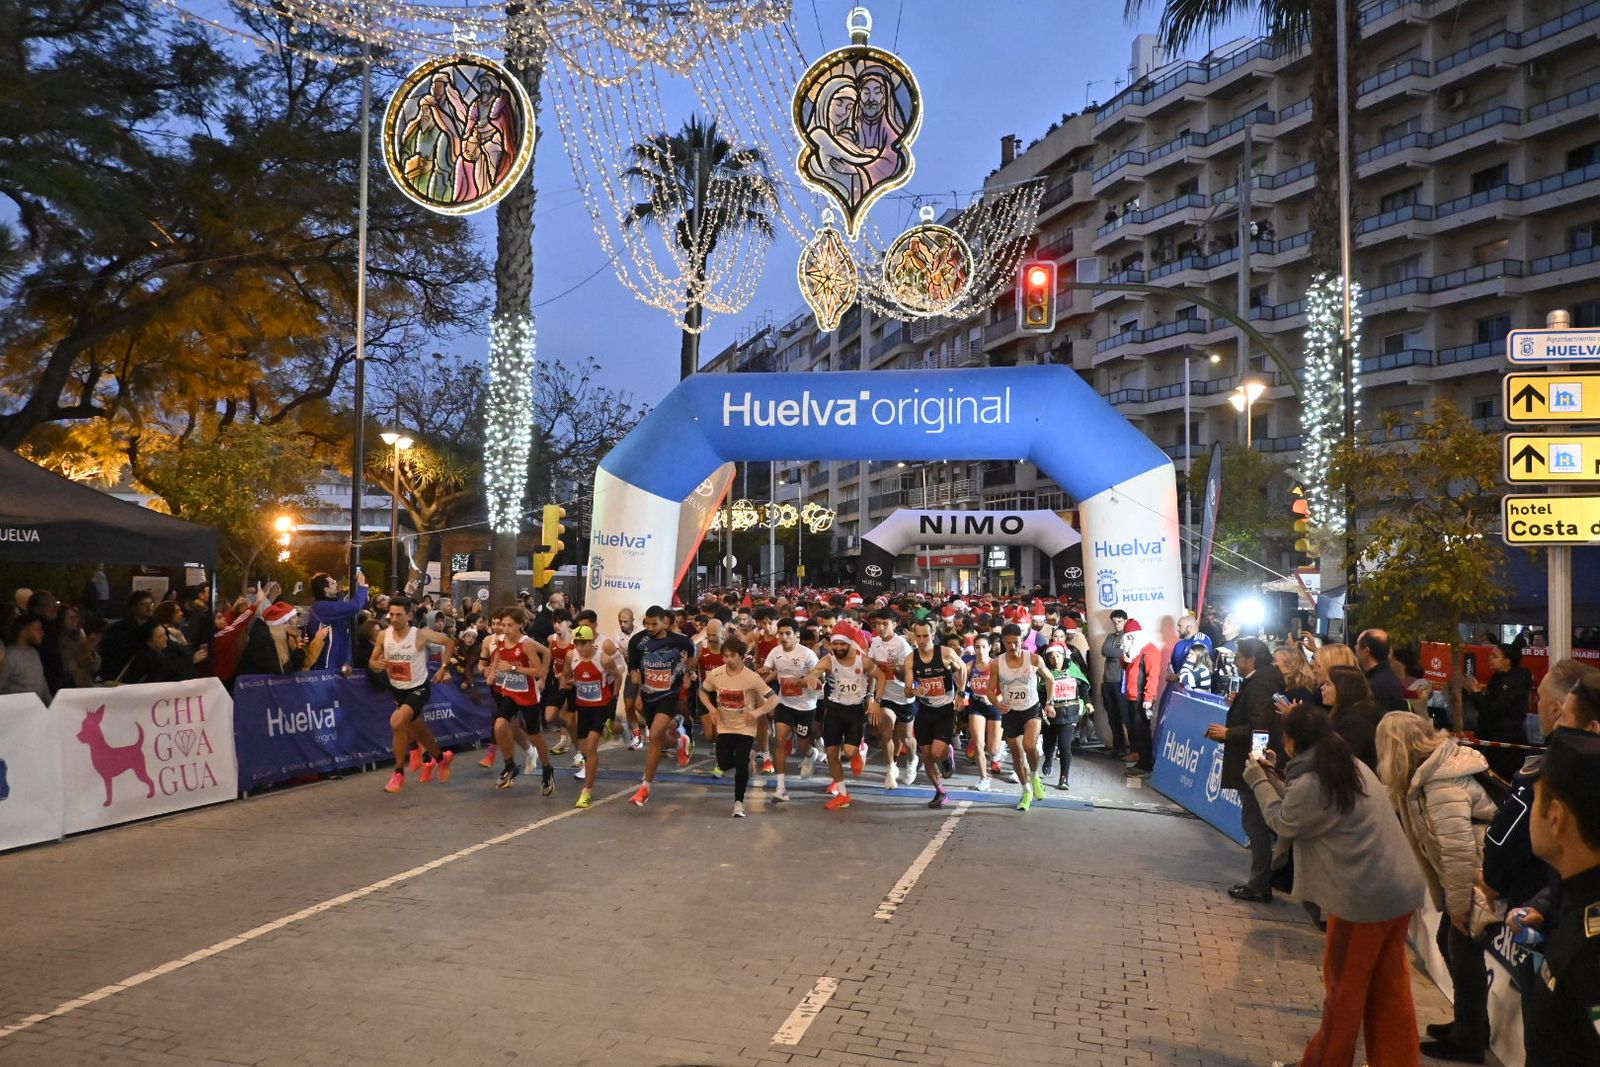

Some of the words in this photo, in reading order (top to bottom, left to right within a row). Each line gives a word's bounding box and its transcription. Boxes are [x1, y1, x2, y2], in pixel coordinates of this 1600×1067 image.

[723, 390, 857, 427] Huelva
[871, 386, 1010, 433] original
[1510, 504, 1552, 515] hotel
[920, 515, 1024, 534] NIMO
[1511, 520, 1578, 536] Costa
[592, 530, 646, 549] Huelva
[1095, 538, 1162, 558] Huelva
[604, 579, 641, 590] HUELVA
[1122, 592, 1165, 602] HUELVA
[643, 660, 672, 668] Huelva
[504, 673, 525, 682] 2590
[646, 673, 669, 682] 2242
[840, 684, 857, 692] 210
[1008, 691, 1026, 700] 720
[151, 696, 205, 728] CHI
[423, 708, 455, 721] HUELVA
[267, 702, 336, 737] Huelva
[1162, 730, 1200, 774] Huelva
[158, 761, 218, 796] GUA
